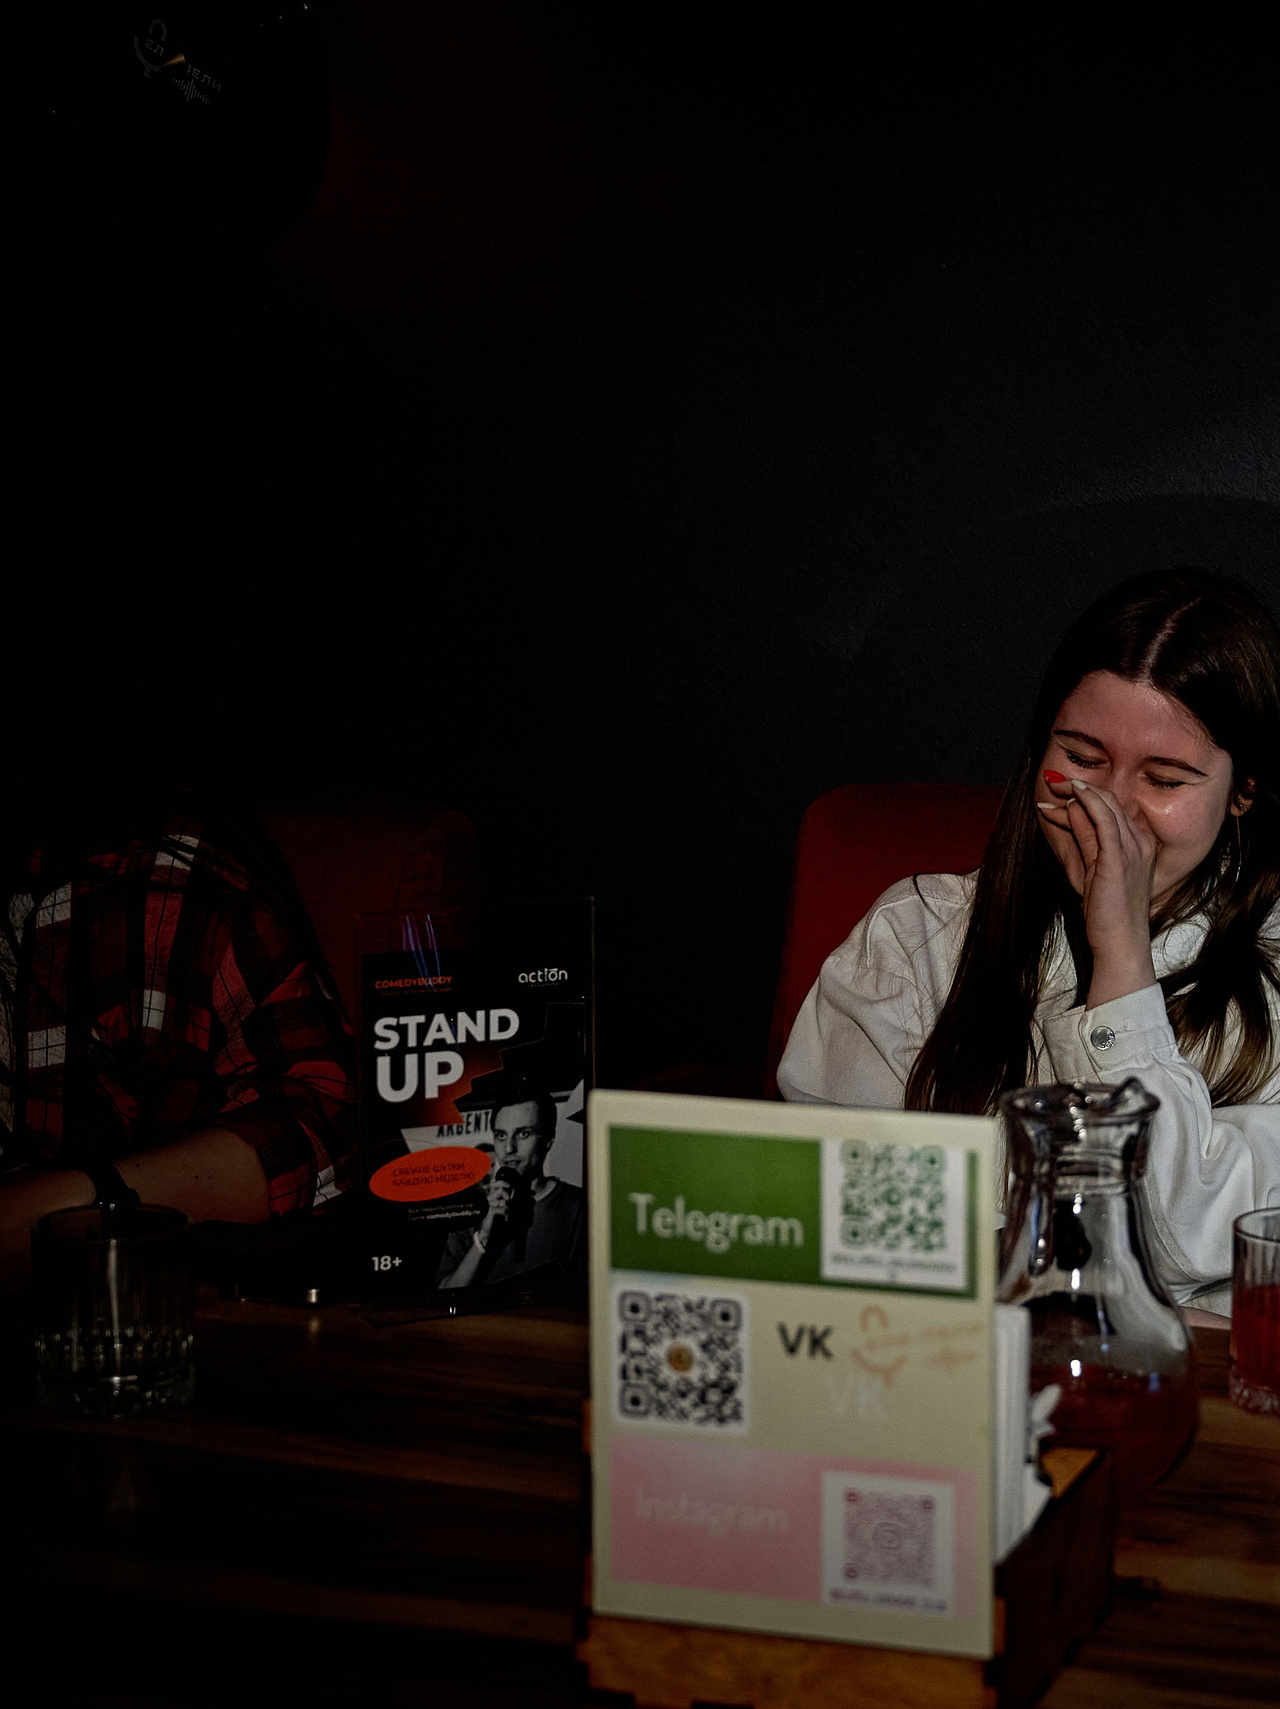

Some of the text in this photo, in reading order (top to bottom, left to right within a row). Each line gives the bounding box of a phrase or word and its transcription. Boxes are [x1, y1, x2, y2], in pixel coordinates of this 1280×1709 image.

[374, 975, 454, 989] COMEDYBUDDY
[373, 1007, 520, 1051] STAND
[376, 1051, 465, 1103] UP
[628, 1192, 805, 1255] Telegram
[371, 1254, 403, 1272] 18+
[777, 1321, 834, 1361] VK
[633, 1486, 791, 1539] Instagram
